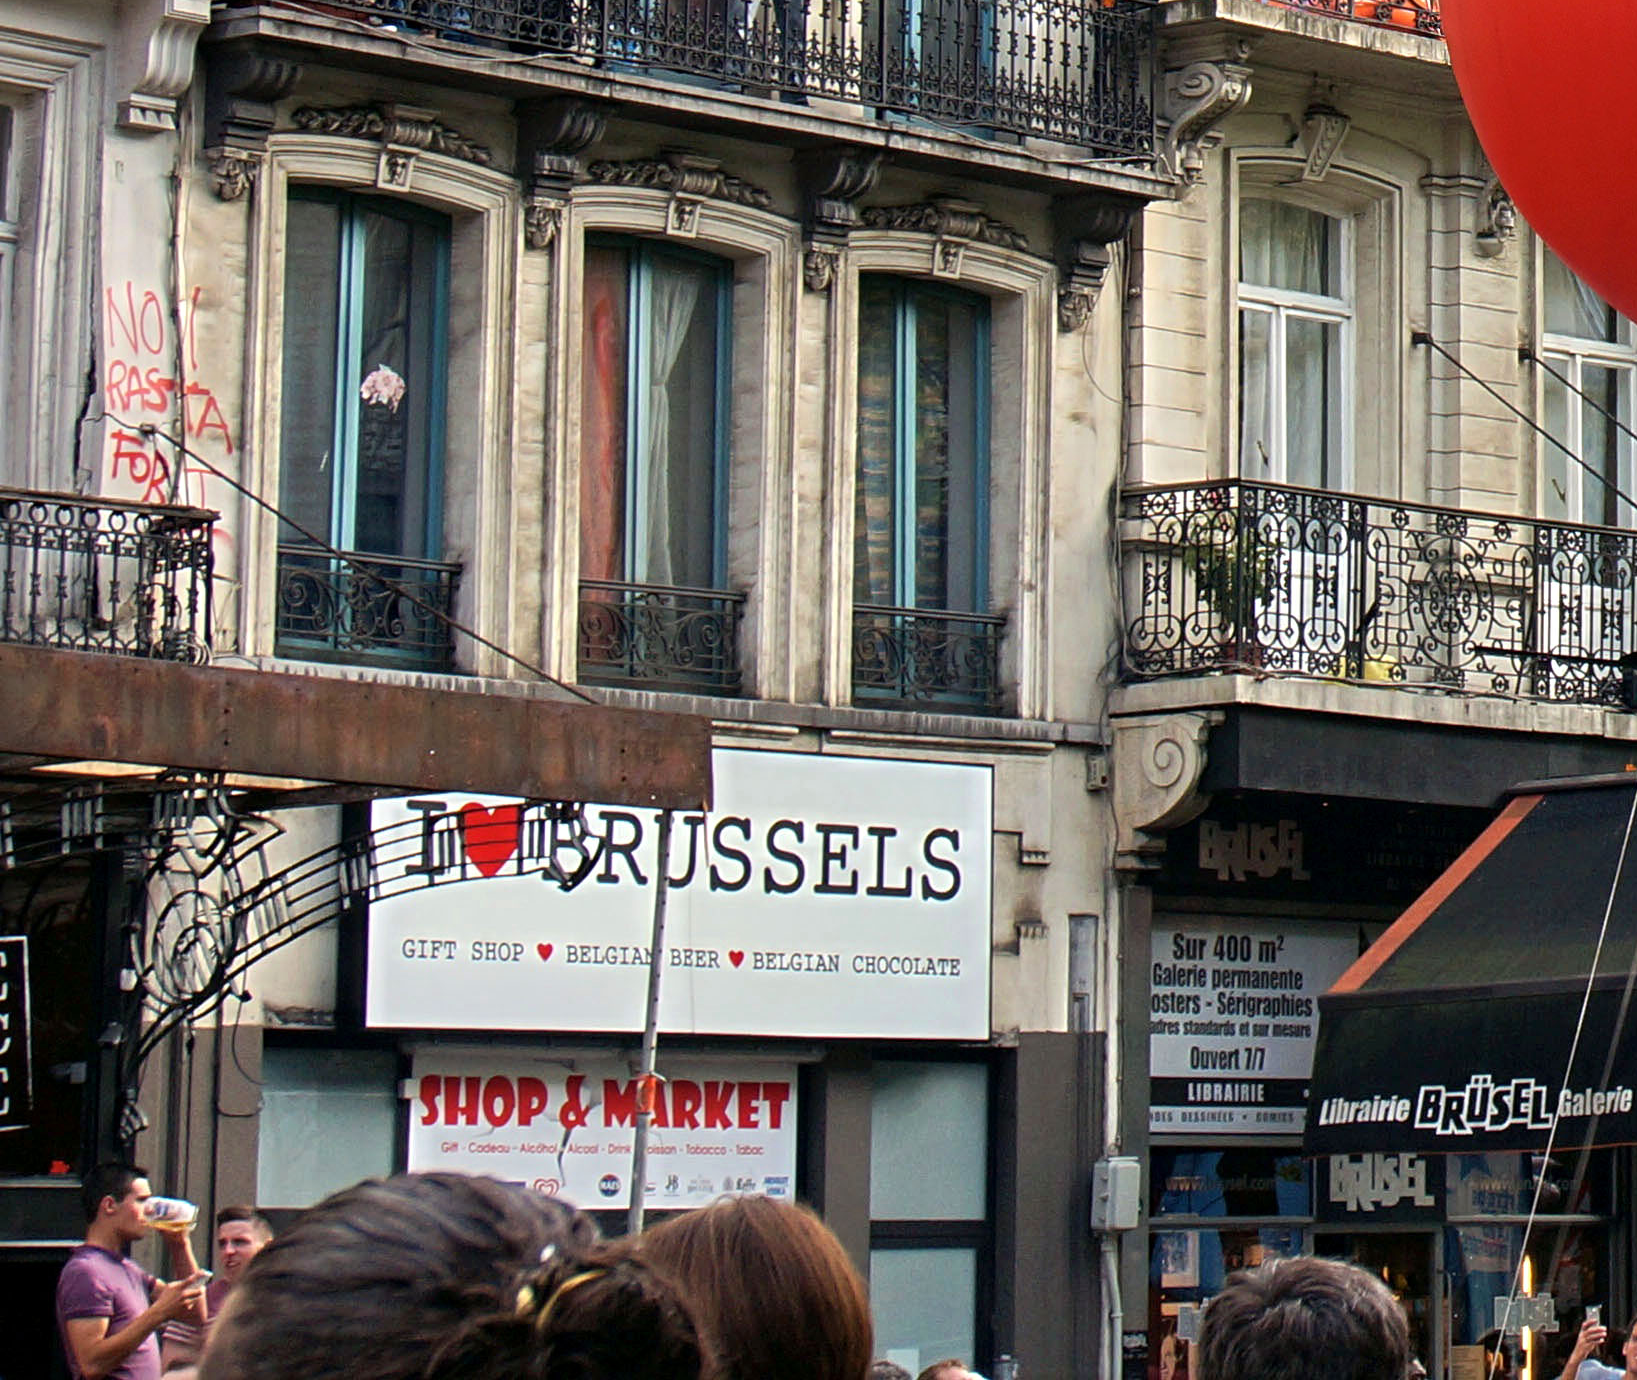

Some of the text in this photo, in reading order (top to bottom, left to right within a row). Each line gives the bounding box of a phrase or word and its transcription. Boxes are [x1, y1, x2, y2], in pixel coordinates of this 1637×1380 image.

[542, 805, 962, 903] BRUSSELS
[402, 939, 457, 961] GIFT
[471, 941, 525, 962] SHOP
[670, 948, 721, 970] BEER
[752, 952, 840, 974] BELGIAN
[852, 955, 961, 977] CHOCOLATE
[1173, 933, 1207, 961] Sur
[1213, 935, 1251, 961] 400
[1153, 963, 1304, 991] Galerie permanente
[1151, 991, 1313, 1019] osters Sérigraphies
[1150, 1019, 1312, 1038] adres standards et sur mesure
[1190, 1046, 1266, 1071] Ouvert 7/7
[419, 1074, 548, 1129] SHOP
[558, 1074, 592, 1131] &
[1187, 1082, 1265, 1102] LIBRAIRIE
[1318, 1074, 1634, 1135] Librairie BRÜSEL Galerie
[468, 1141, 511, 1155] Cadeau
[648, 1144, 677, 1156] oisson
